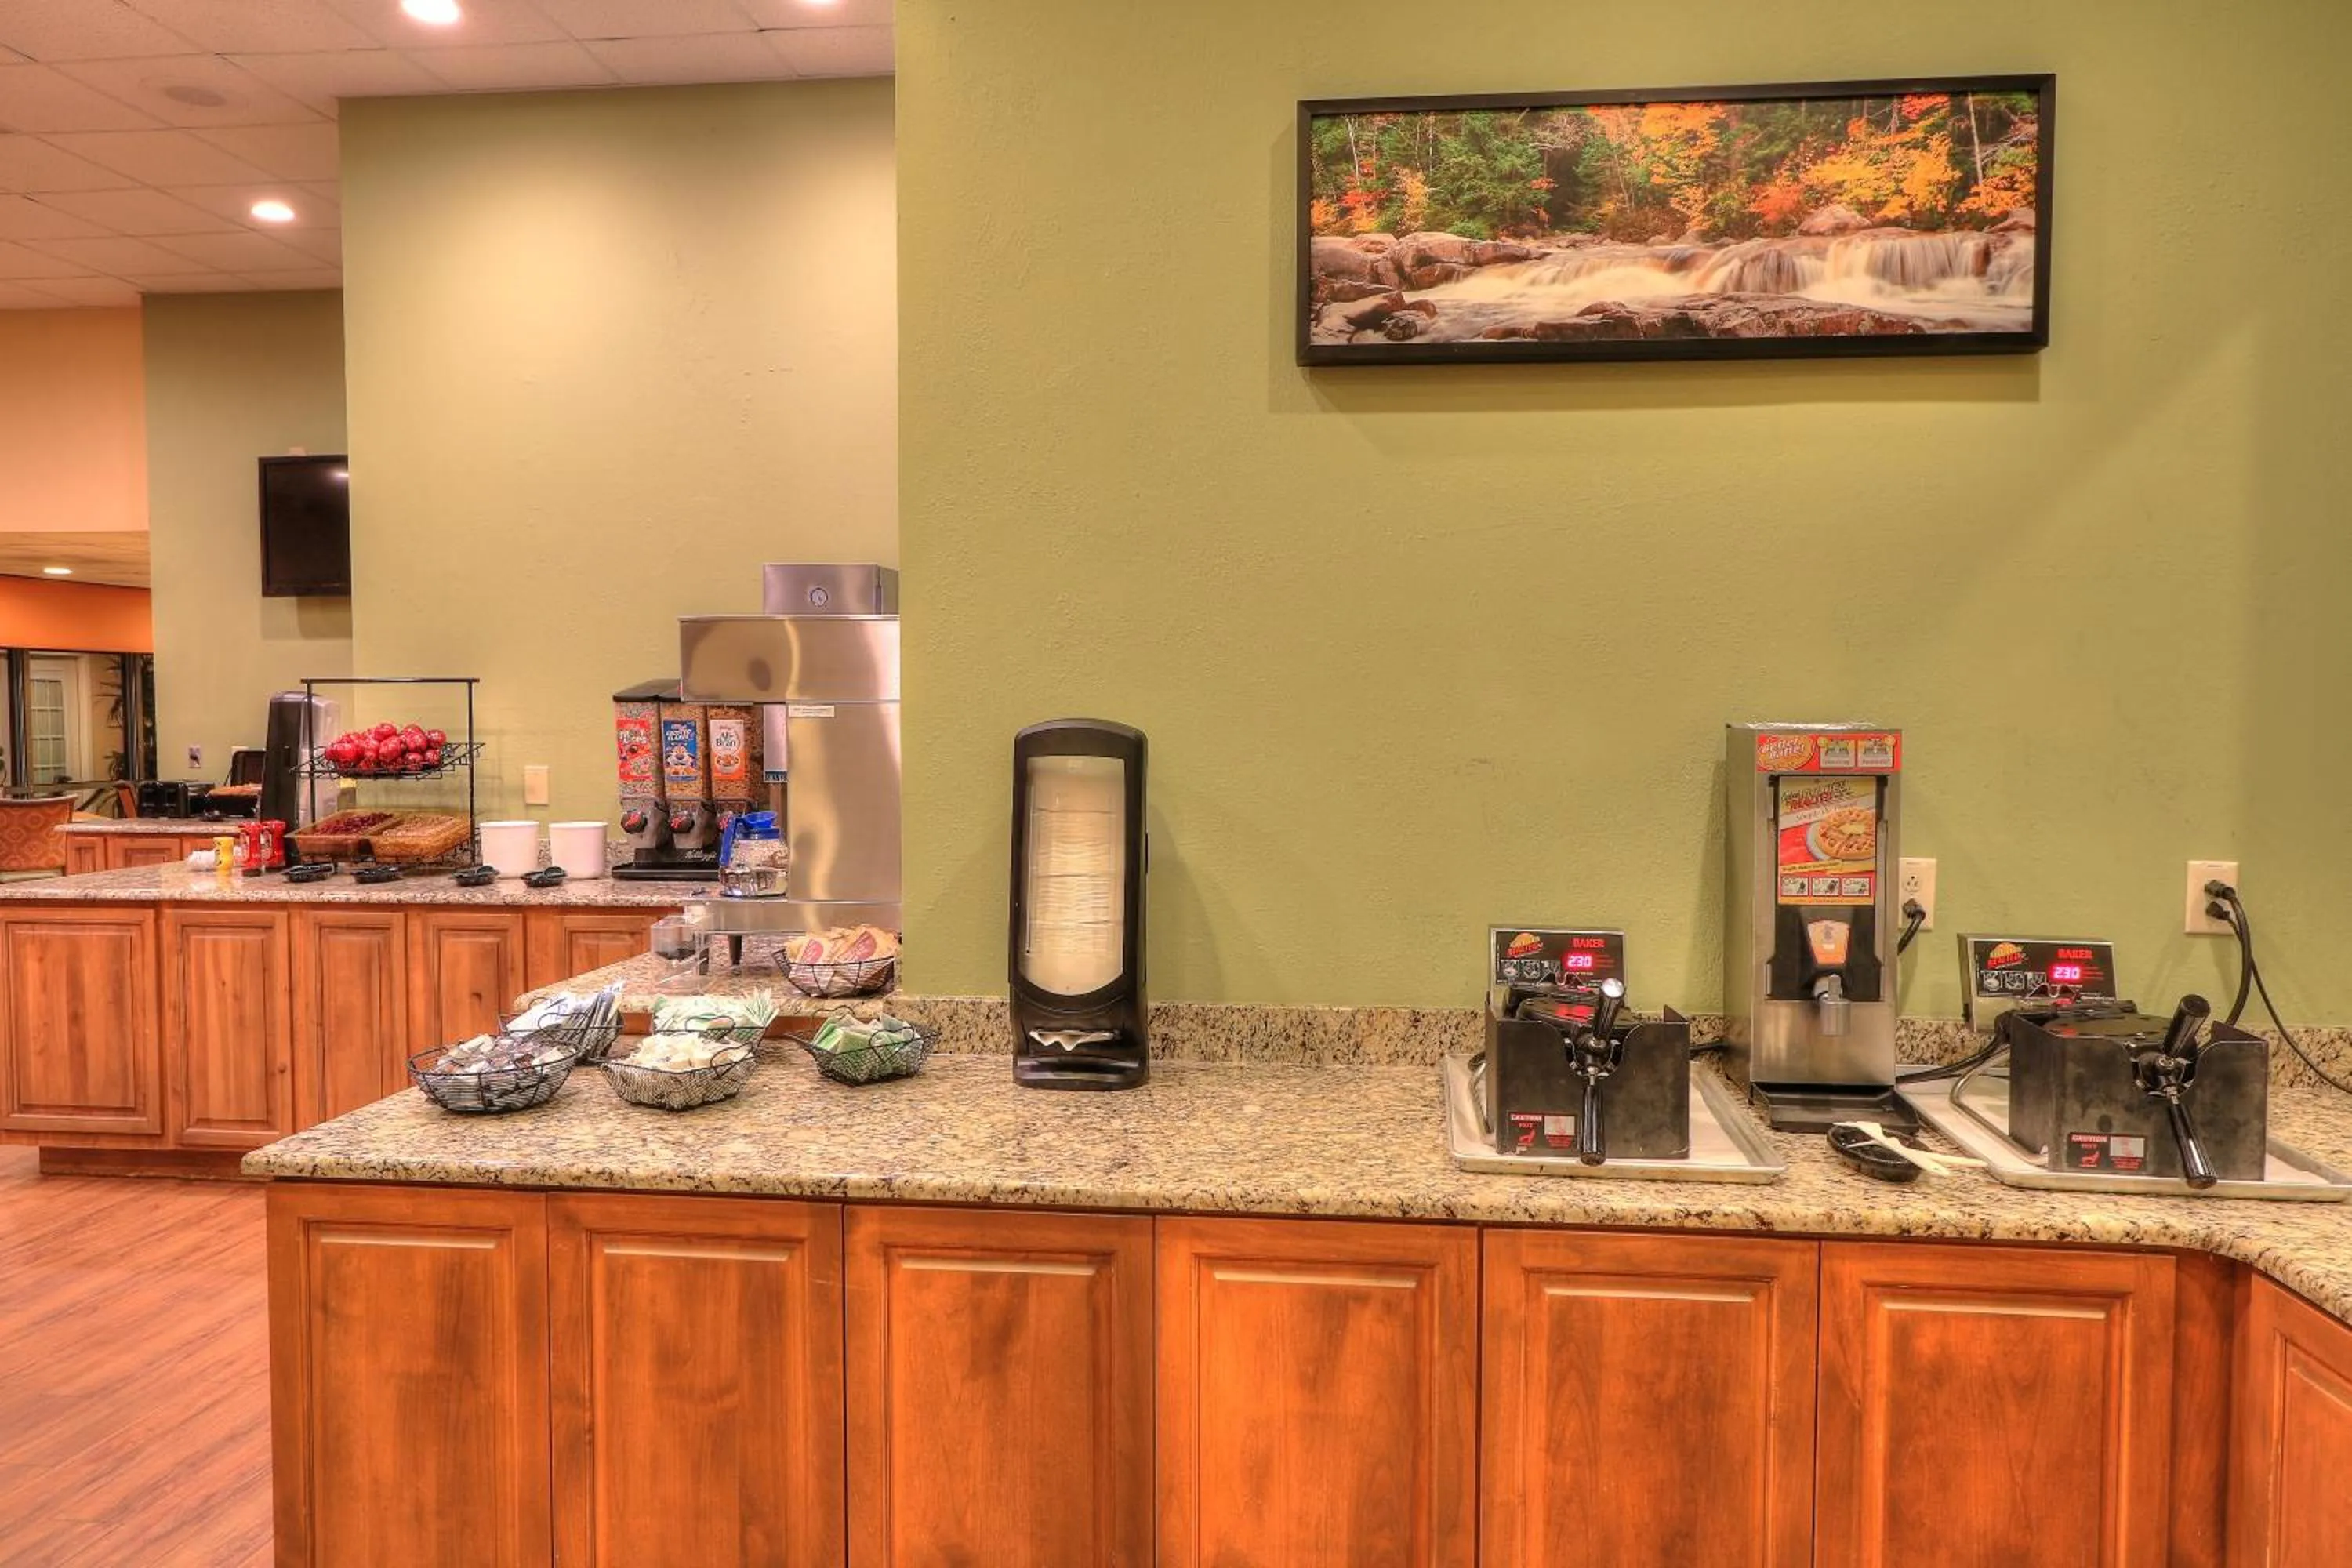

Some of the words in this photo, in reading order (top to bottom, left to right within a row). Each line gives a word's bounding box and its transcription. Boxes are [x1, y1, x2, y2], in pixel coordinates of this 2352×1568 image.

[1573, 938, 1605, 948] BAKER
[2057, 949, 2092, 959] BAKER
[2053, 967, 2081, 978] 230
